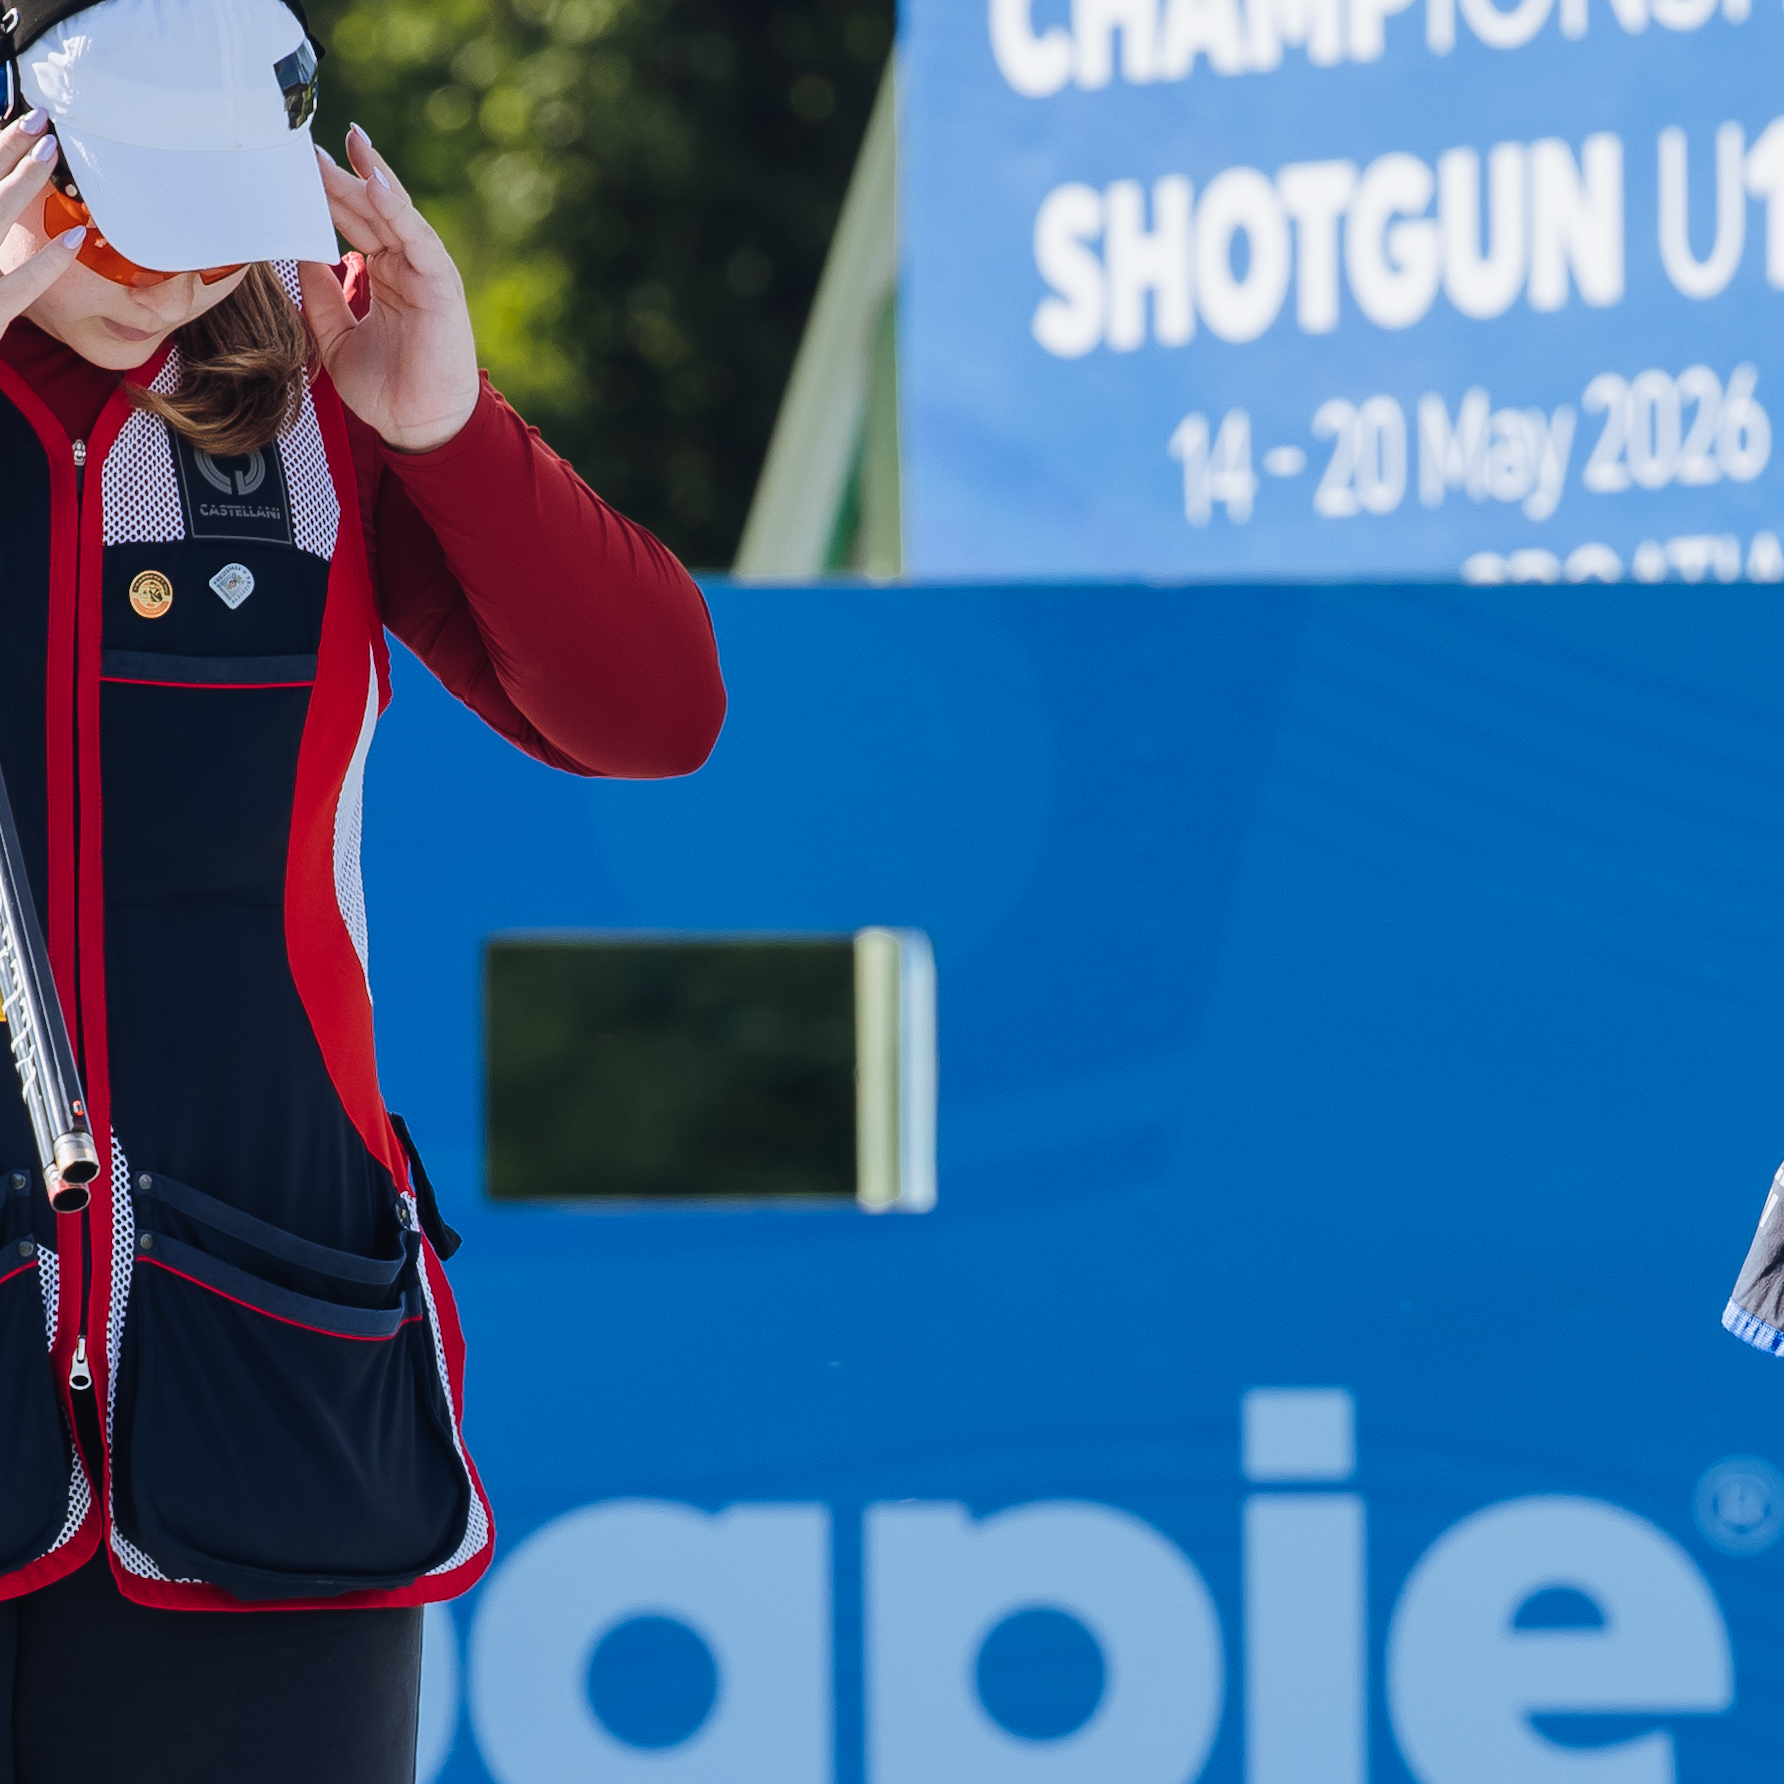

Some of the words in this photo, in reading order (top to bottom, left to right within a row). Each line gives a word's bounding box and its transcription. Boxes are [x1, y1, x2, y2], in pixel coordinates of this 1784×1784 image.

[1031, 130, 1624, 359] SHOTGUN
[200, 503, 281, 520] CASTELLANI
[1169, 407, 1258, 529] 14
[1312, 395, 1407, 517] 20
[1418, 385, 1577, 521] May
[1582, 361, 1772, 494] 2026
